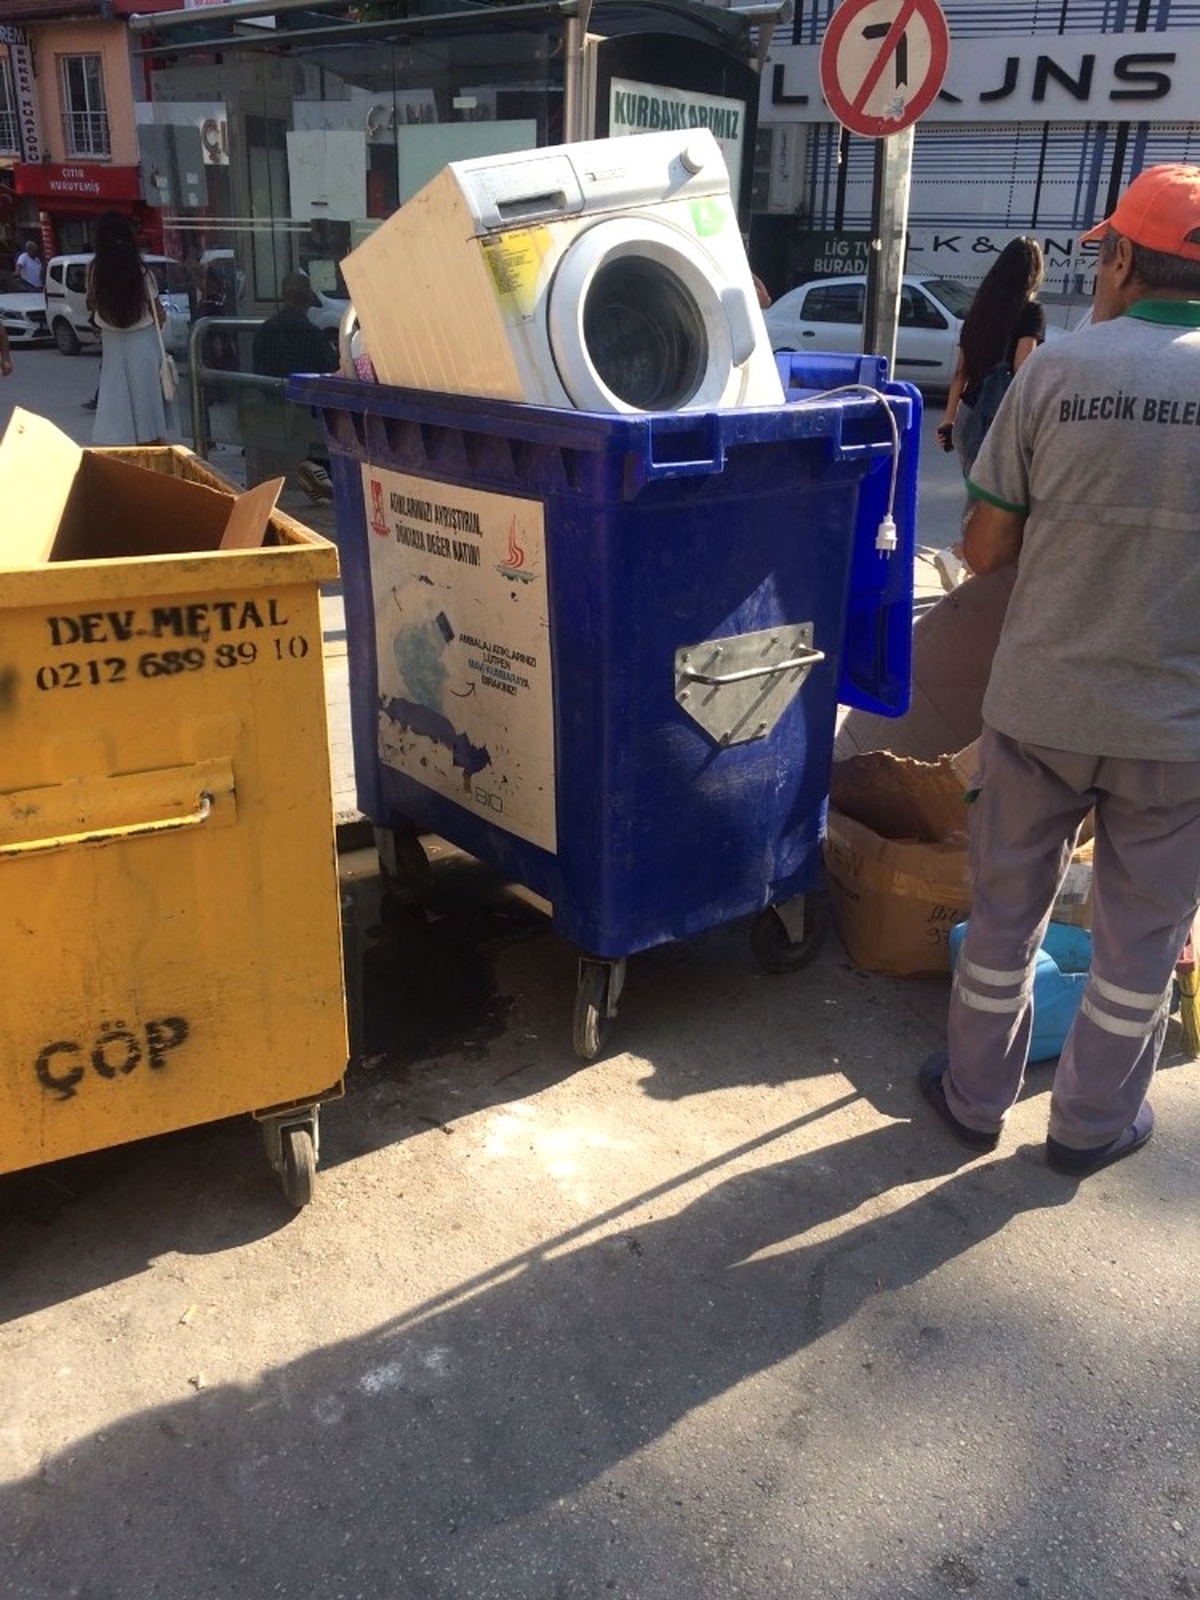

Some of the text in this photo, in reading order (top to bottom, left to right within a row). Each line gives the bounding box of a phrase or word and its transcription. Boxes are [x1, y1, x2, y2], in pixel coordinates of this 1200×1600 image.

[825, 237, 850, 256] LİG
[1059, 390, 1200, 427] BİLECİK BELE
[36, 635, 308, 691] 0212 689 89 10
[35, 1016, 190, 1102] ÇÖP
